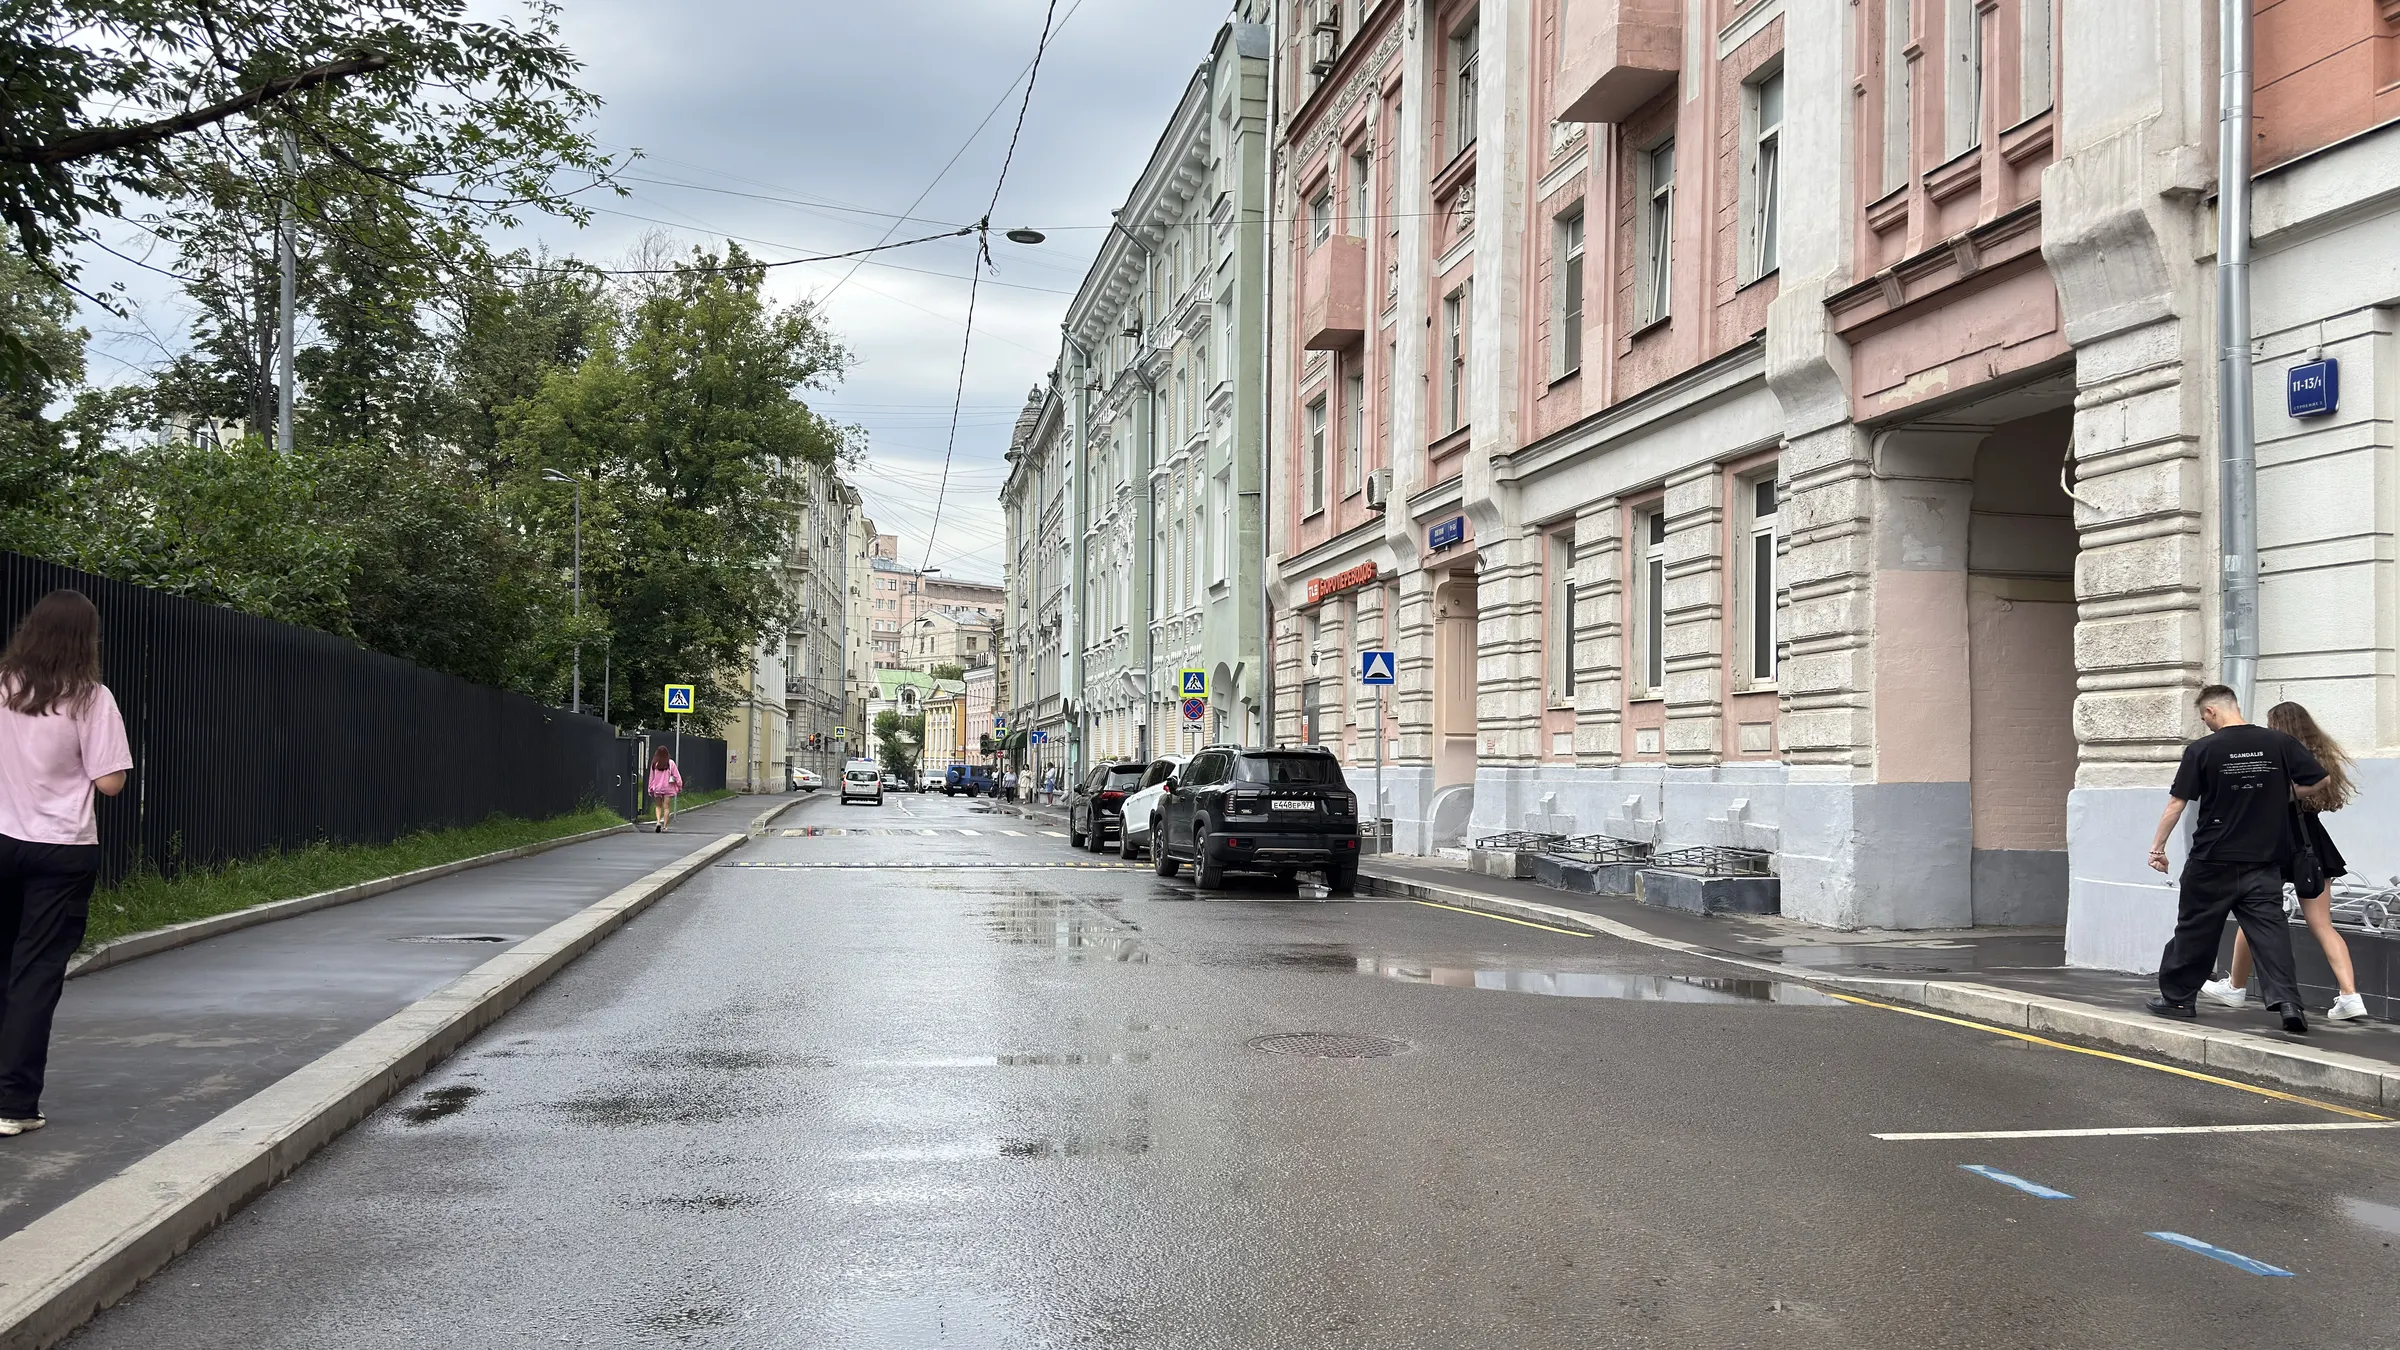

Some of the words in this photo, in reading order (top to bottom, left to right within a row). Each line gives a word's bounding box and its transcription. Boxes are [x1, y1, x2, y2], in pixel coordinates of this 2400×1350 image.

[2293, 376, 2322, 392] 11-13/1
[1337, 563, 1374, 590] ПЕРЕВОДОВ
[2229, 751, 2264, 759] SCANDALIS
